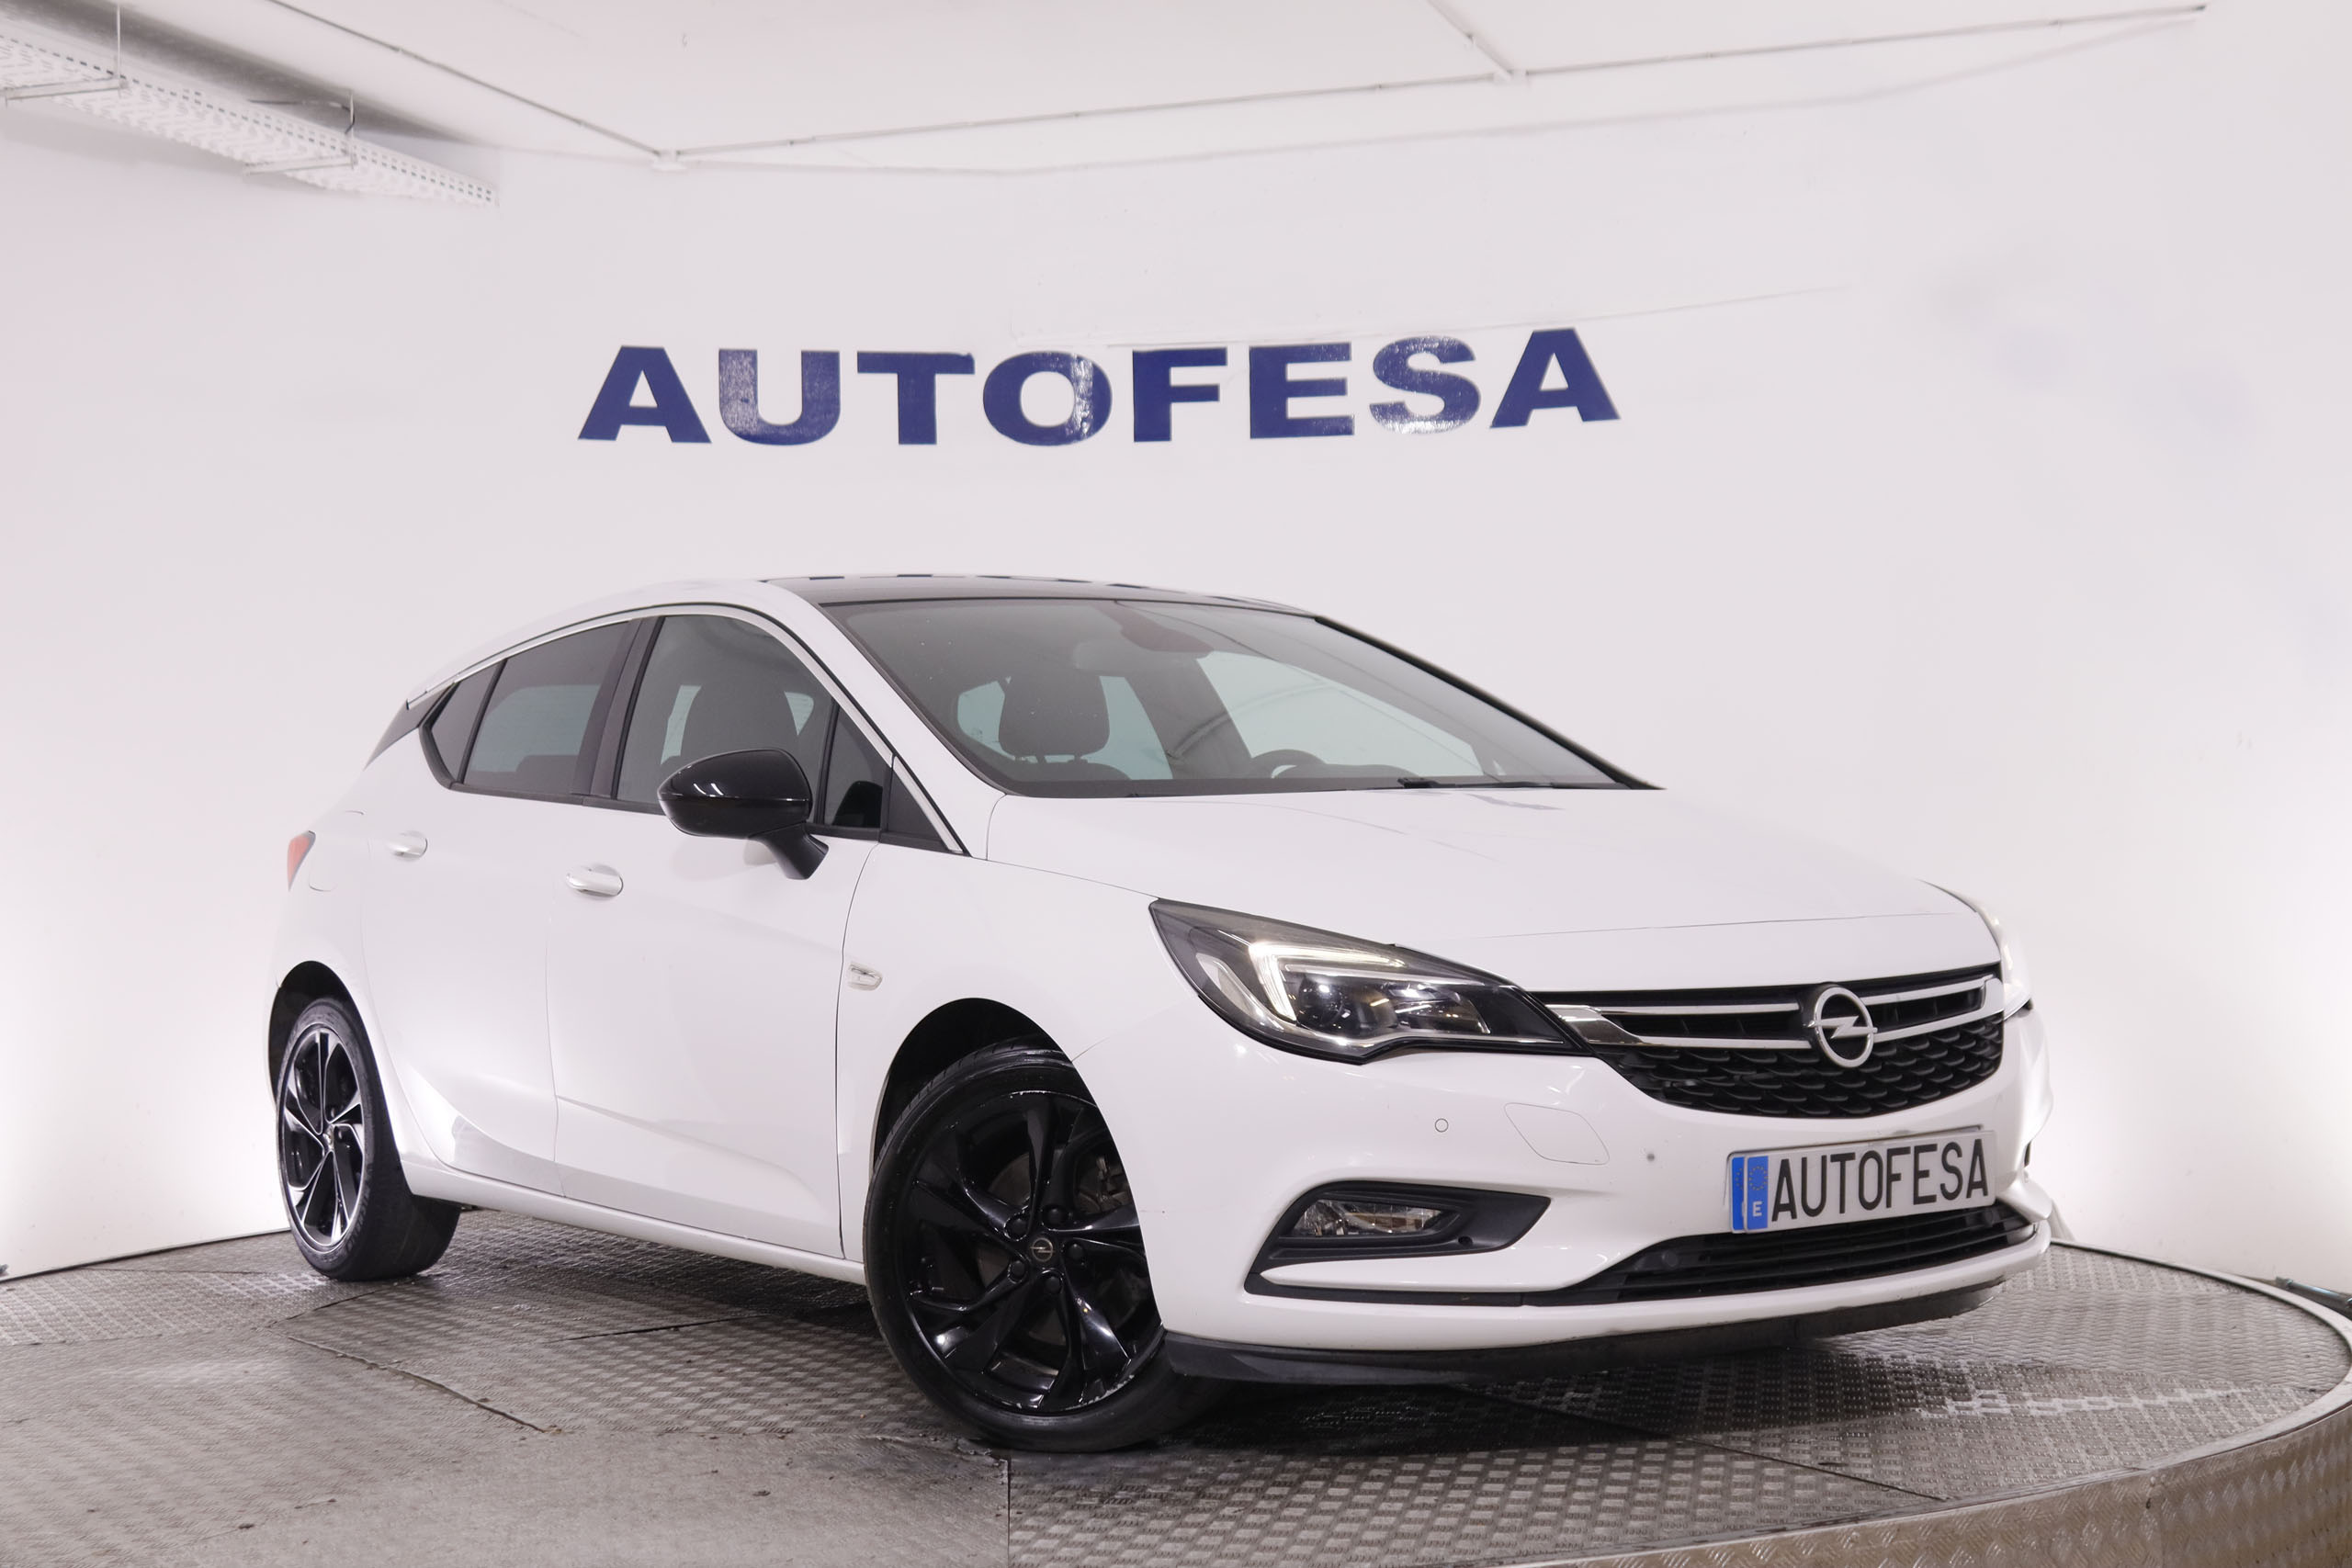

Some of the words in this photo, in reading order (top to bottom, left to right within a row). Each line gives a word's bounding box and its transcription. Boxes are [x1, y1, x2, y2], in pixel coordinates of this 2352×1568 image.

[578, 328, 1620, 446] AUTOFESA
[1752, 1201, 1763, 1217] E
[1771, 1139, 1988, 1222] AUTOFESA
